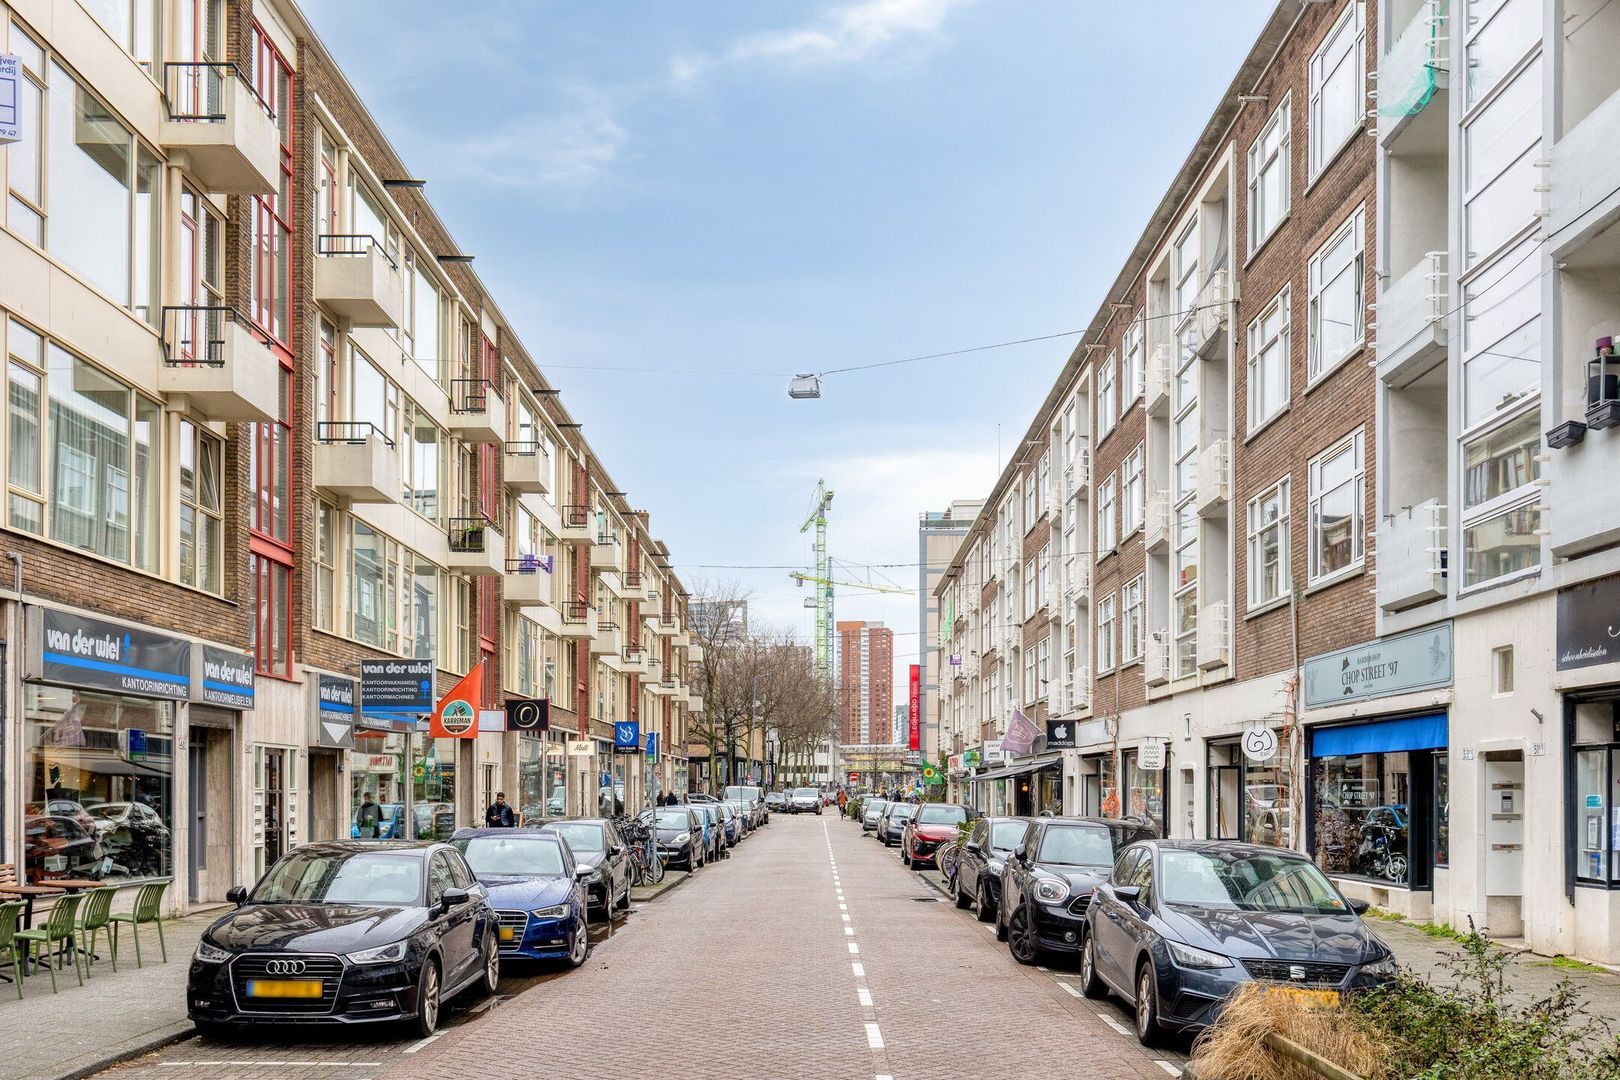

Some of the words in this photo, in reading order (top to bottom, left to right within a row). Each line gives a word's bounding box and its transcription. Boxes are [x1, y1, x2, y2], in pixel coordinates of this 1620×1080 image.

[47, 629, 70, 651] van
[72, 629, 95, 655] der
[96, 634, 120, 660] wiel
[204, 661, 220, 678] van
[220, 661, 236, 681] der
[235, 664, 252, 685] wiel
[363, 665, 384, 674] van
[386, 662, 407, 674] der
[408, 662, 432, 674] wiel
[1341, 669, 1361, 686] CHOP
[1360, 663, 1386, 682] STREET
[1387, 660, 1398, 677] '97
[122, 676, 187, 697] KANTOORINRICHTING
[320, 686, 331, 700] van
[330, 684, 341, 702] der
[340, 687, 353, 704] wiel
[204, 689, 253, 706] KANTOORMEUBELEN
[443, 717, 471, 725] KARREMAN
[1342, 791, 1354, 800] CHOP
[1353, 791, 1368, 800] STREET
